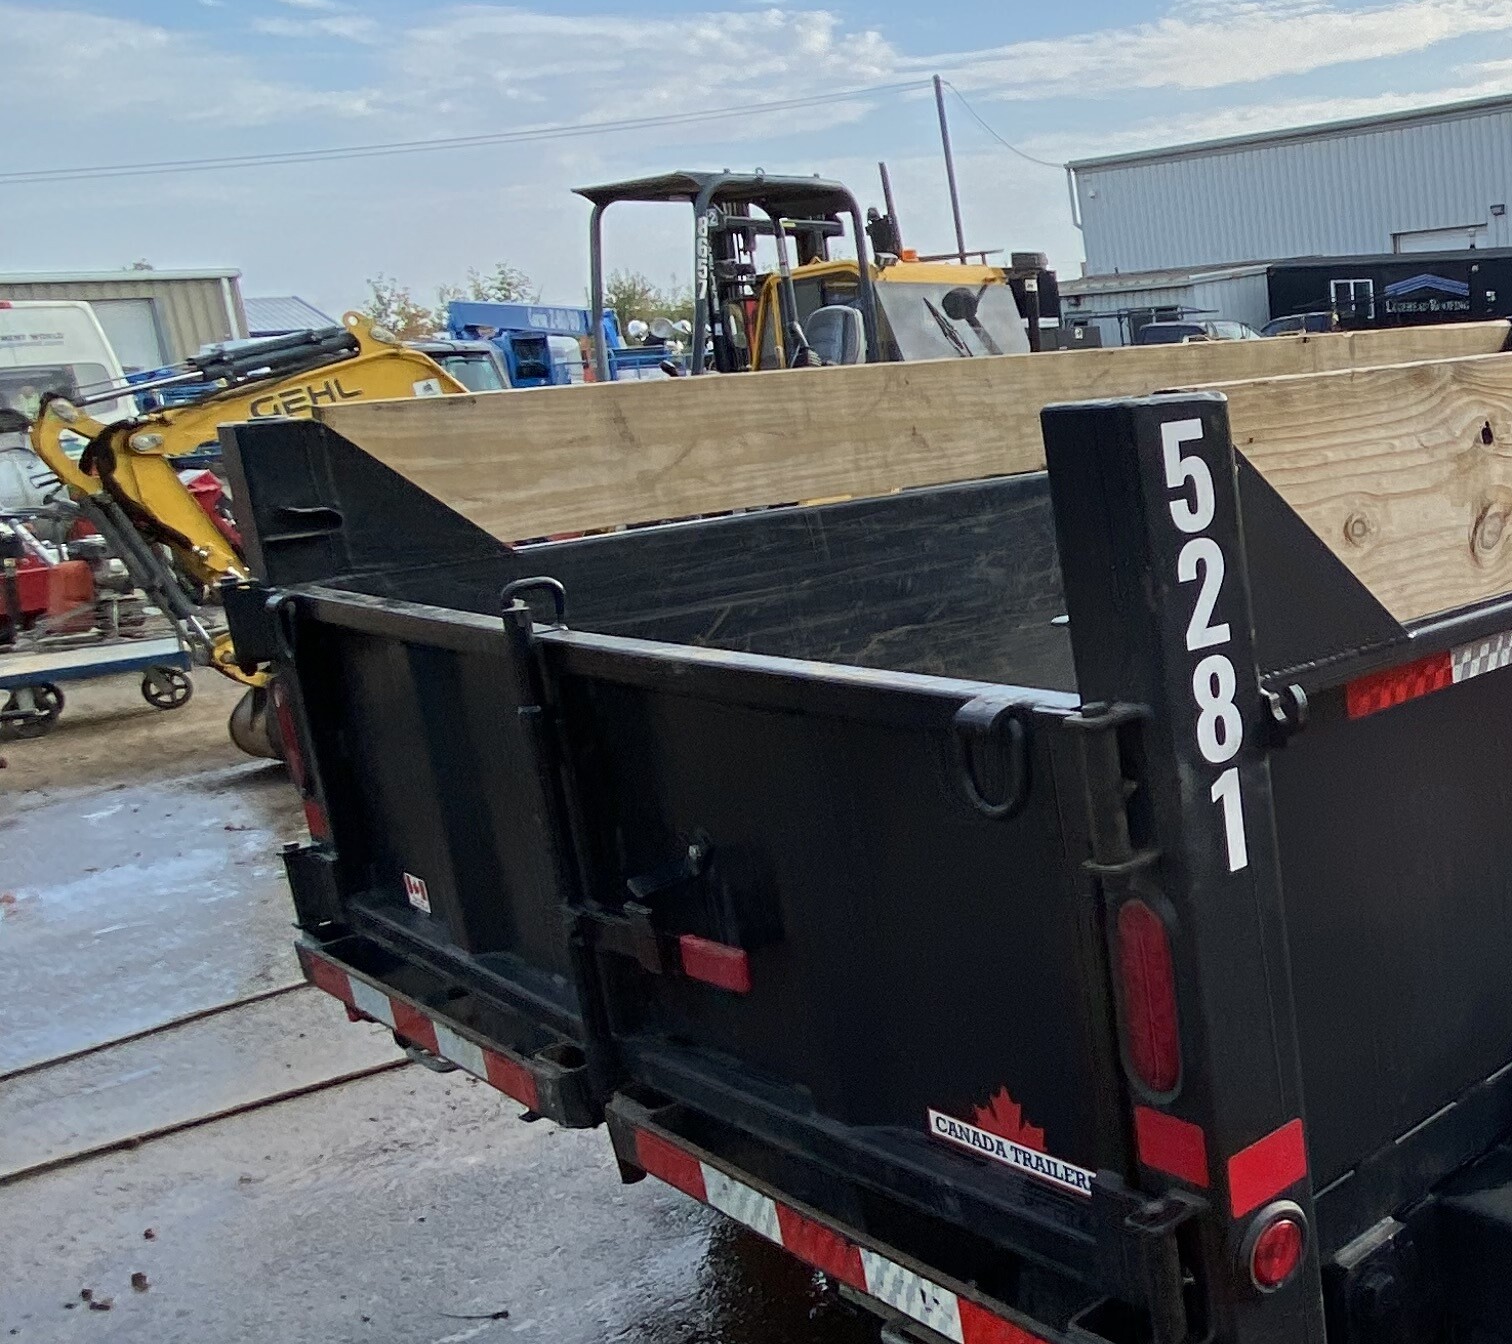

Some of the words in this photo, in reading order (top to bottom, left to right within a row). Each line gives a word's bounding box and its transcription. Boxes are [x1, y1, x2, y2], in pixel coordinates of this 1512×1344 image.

[697, 216, 708, 300] 8657
[250, 378, 364, 417] GEHL
[1160, 417, 1249, 872] 5281
[936, 1115, 1008, 1160] CANADA
